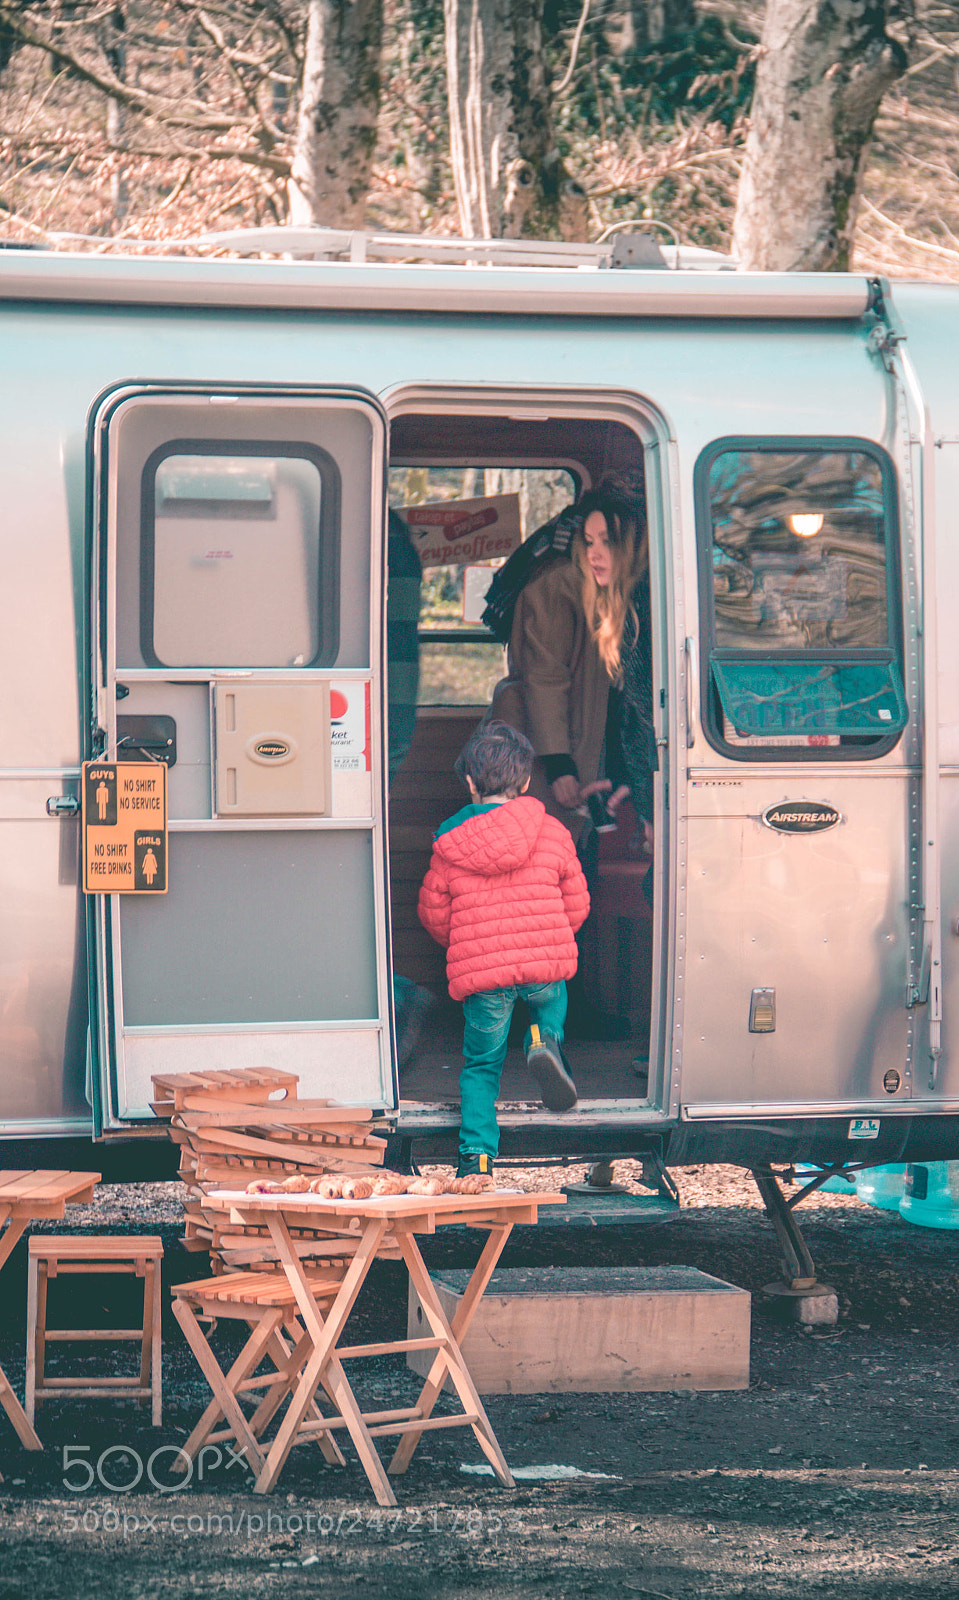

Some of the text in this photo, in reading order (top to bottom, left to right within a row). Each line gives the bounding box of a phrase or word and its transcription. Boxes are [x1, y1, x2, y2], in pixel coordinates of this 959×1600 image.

[416, 535, 513, 563] eupcoffees
[90, 770, 115, 780] GUYS
[124, 779, 156, 792] NO SHIRT
[120, 797, 161, 810] NO SERVICE
[768, 811, 838, 823] AIRSTREAM
[136, 836, 161, 846] GIRLS
[94, 844, 128, 857] NO SHIRT
[90, 862, 132, 875] FREE DRINKS
